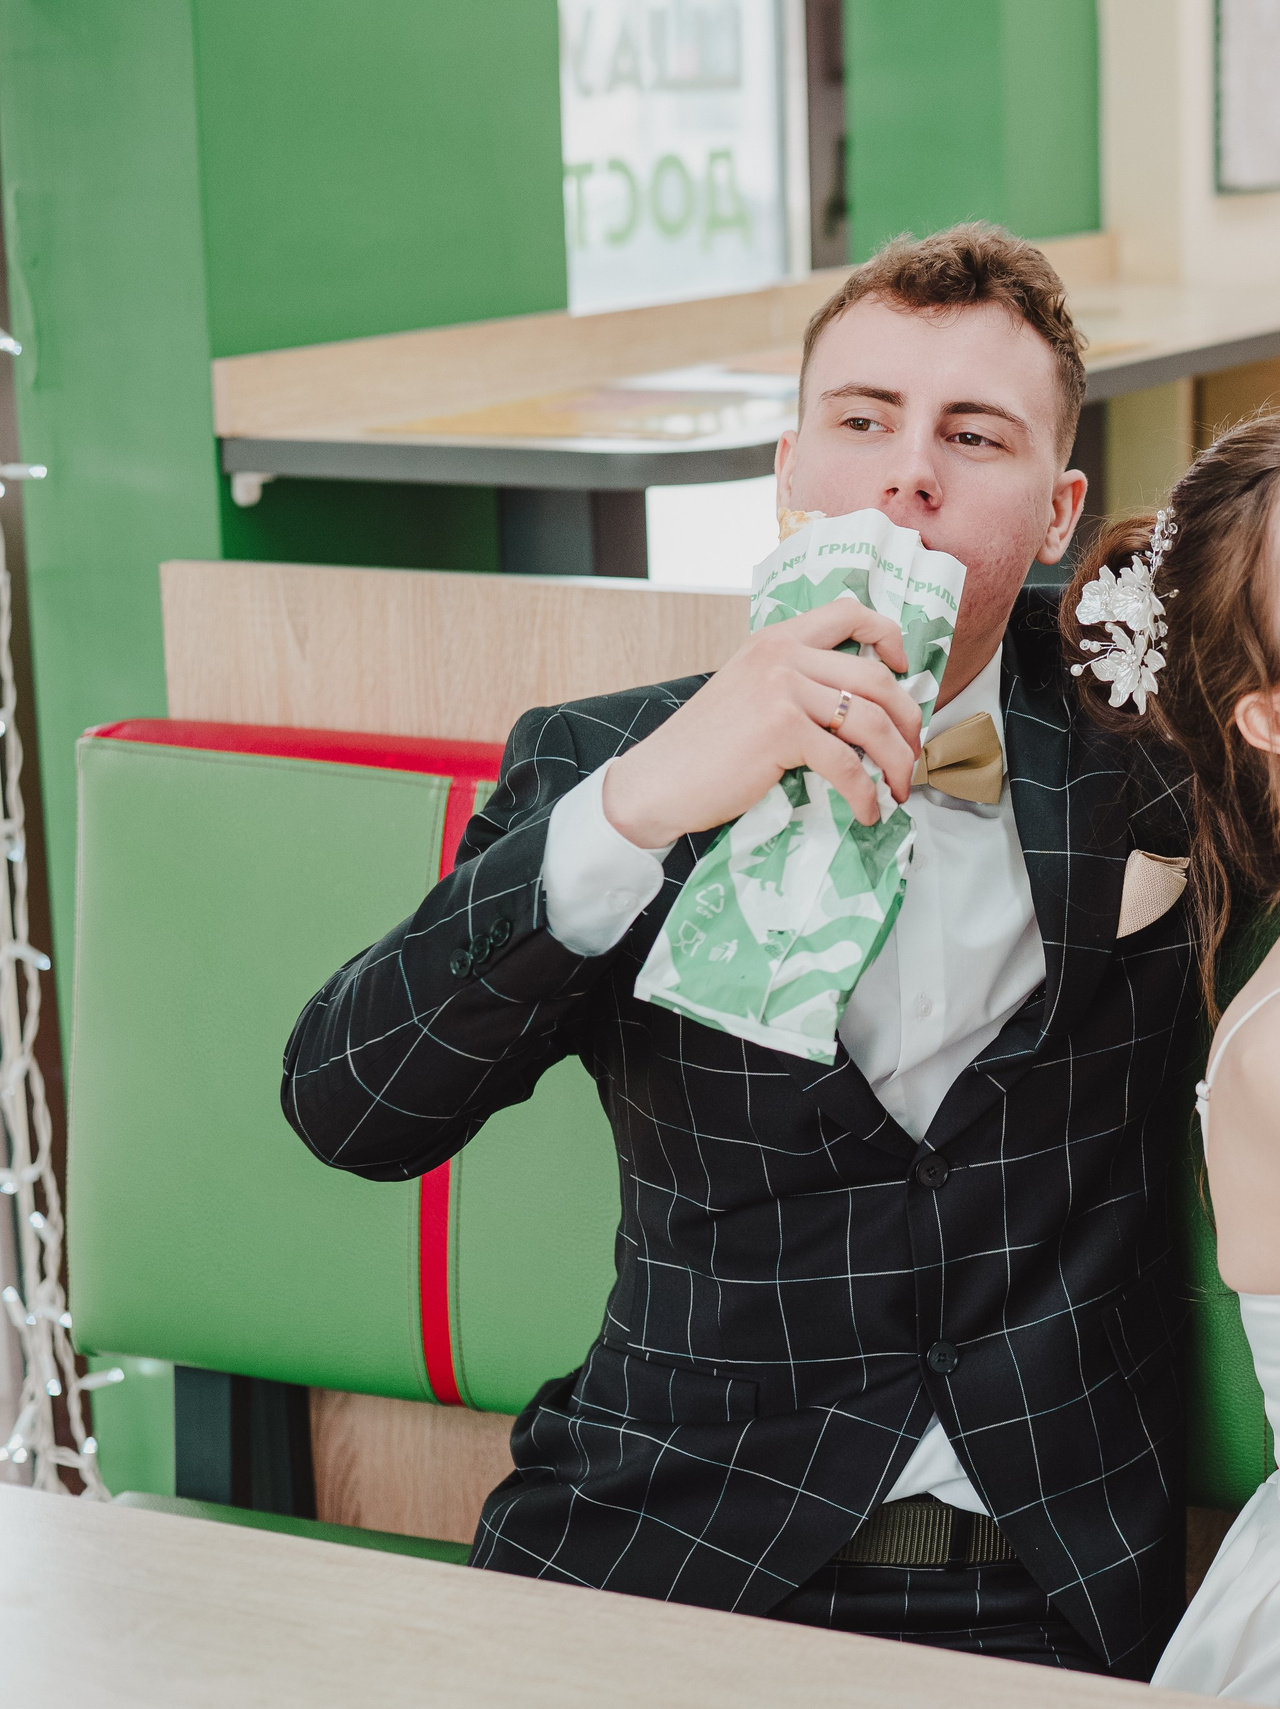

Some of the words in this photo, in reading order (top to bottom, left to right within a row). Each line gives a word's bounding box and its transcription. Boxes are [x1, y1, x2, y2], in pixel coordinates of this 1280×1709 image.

[817, 541, 879, 561] ГРИЛЬ
[876, 556, 904, 581] №1
[906, 577, 958, 611] ГРИЛЬ
